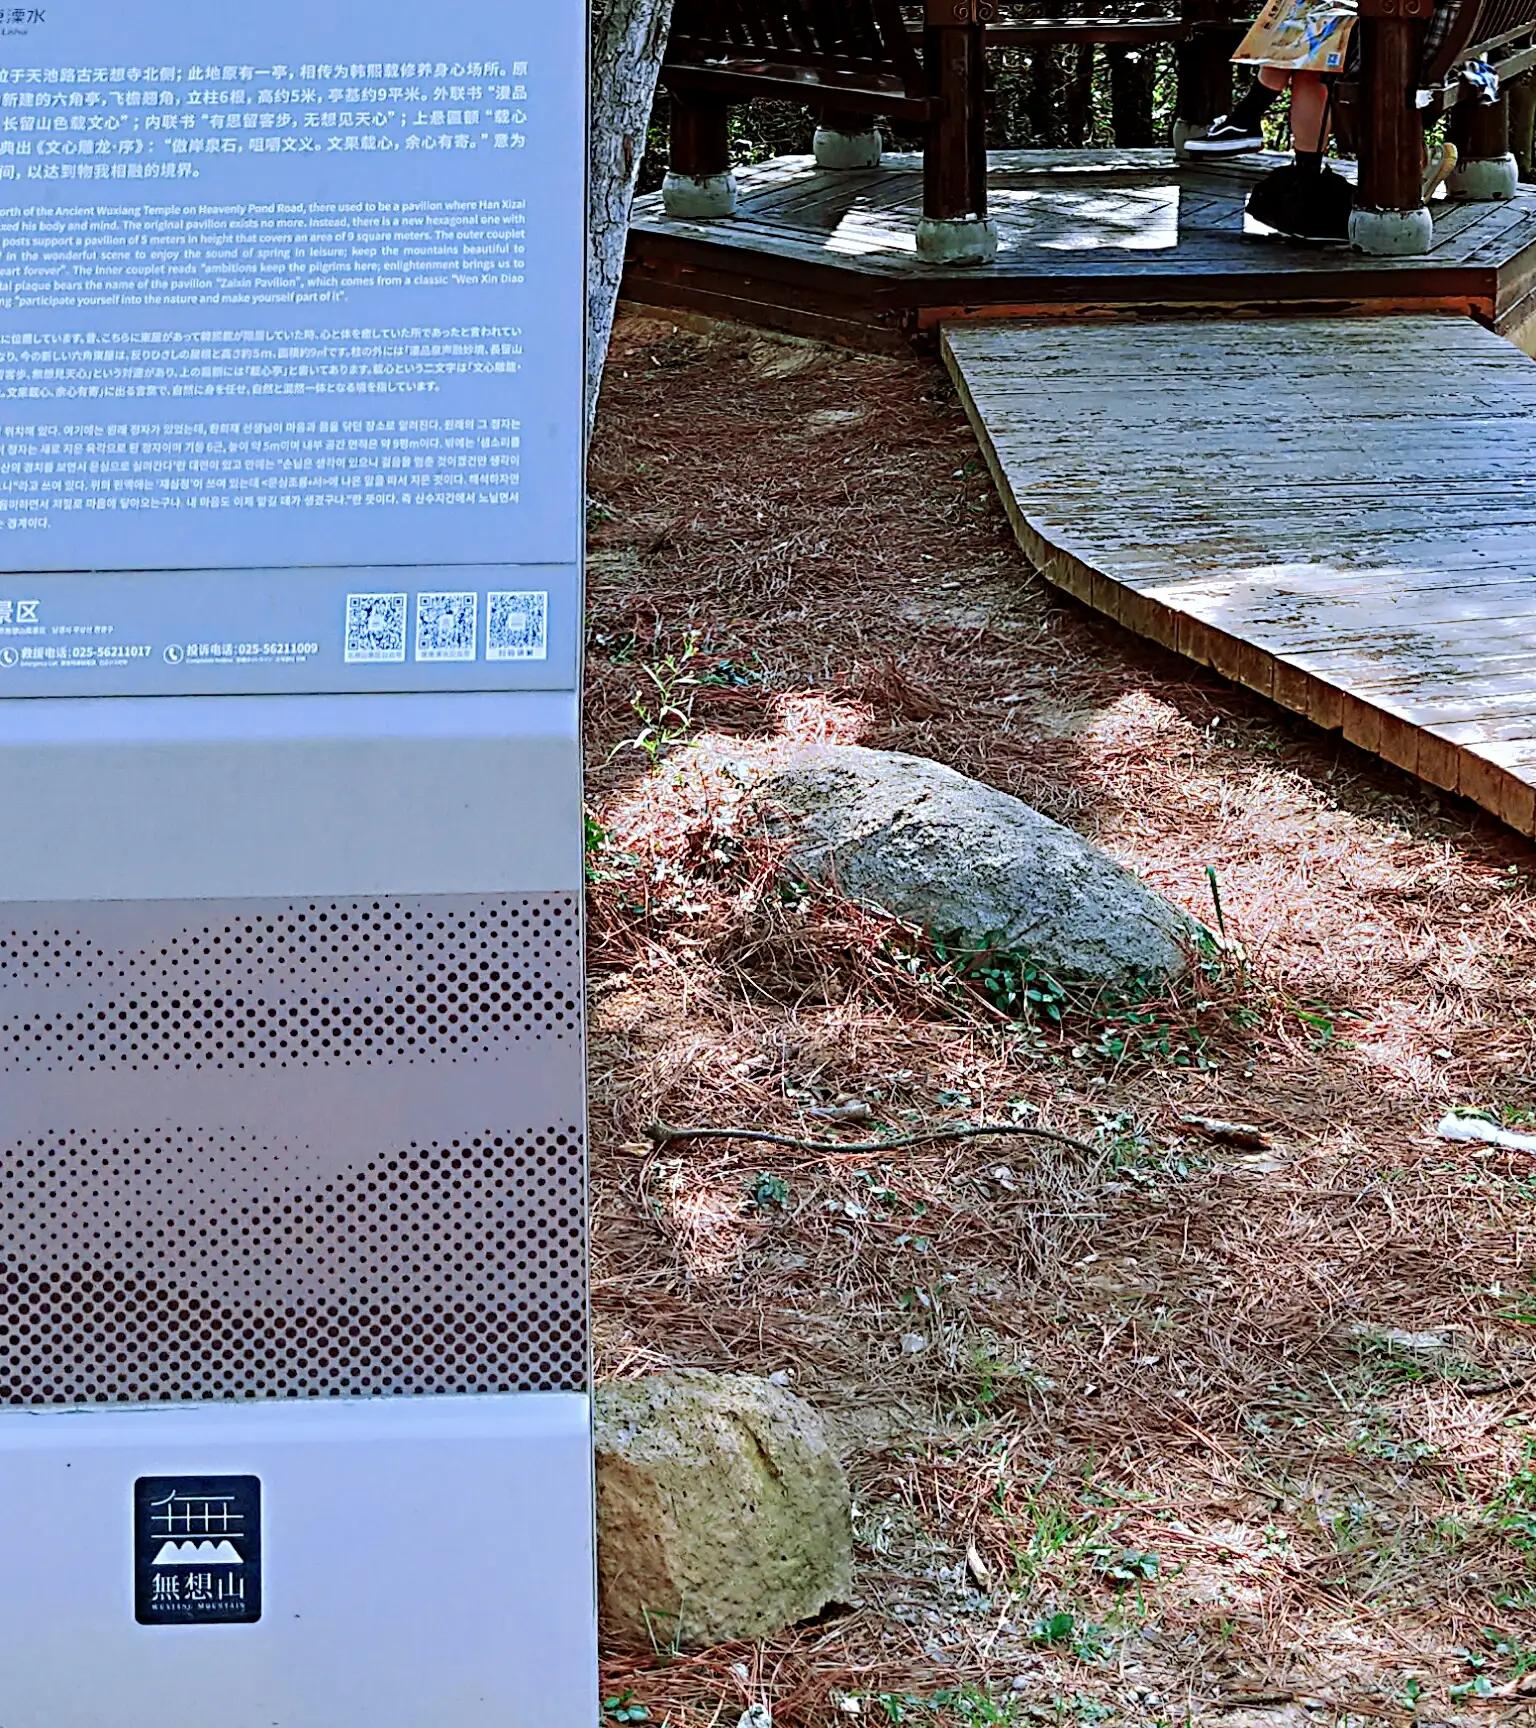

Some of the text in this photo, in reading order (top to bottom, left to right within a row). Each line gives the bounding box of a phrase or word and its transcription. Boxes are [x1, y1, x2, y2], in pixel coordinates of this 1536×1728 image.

[23, 206, 34, 216] of
[36, 205, 54, 216] the
[54, 205, 94, 216] Ancient
[96, 204, 141, 218] Wuxiang
[143, 204, 181, 216] Temple
[182, 206, 196, 214] on
[198, 203, 246, 216] Heavenly
[247, 203, 275, 213] Pond
[308, 201, 336, 212] there
[338, 201, 362, 212] used
[365, 202, 376, 211] to
[377, 199, 391, 211] be
[401, 200, 442, 213] pavilion
[444, 199, 477, 210] where
[479, 199, 499, 210] Han
[501, 198, 525, 209] Xizai
[21, 221, 36, 231] his
[39, 220, 66, 233] body
[67, 220, 88, 230] and
[122, 220, 142, 230] The
[143, 219, 183, 231] original
[185, 218, 227, 231] pavilion
[229, 218, 259, 228] exists
[260, 219, 274, 228] no
[352, 215, 379, 227] there
[381, 215, 390, 226] is
[401, 217, 423, 225] new
[426, 213, 478, 227] hexagonal
[480, 215, 500, 224] one
[502, 213, 525, 224] with
[2, 237, 30, 248] posts
[31, 236, 73, 247] support
[84, 234, 126, 247] pavilion
[127, 234, 139, 245] of
[149, 235, 185, 245] meters
[187, 234, 197, 244] in
[200, 233, 233, 246] height
[235, 233, 256, 243] that
[258, 234, 292, 243] covers
[294, 233, 307, 242] an
[309, 233, 332, 242] area
[334, 231, 346, 241] of
[356, 232, 391, 243] square
[434, 229, 454, 240] The
[456, 229, 484, 239] outer
[486, 228, 525, 240] couplet
[6, 251, 16, 261] in
[21, 250, 38, 261] the
[42, 249, 96, 261] wonderful
[101, 251, 130, 260] scene
[135, 250, 146, 260] to
[150, 249, 179, 262] enjoy
[183, 248, 201, 259] the
[205, 247, 238, 258] sound
[242, 247, 254, 258] of
[257, 247, 290, 260] spring
[295, 247, 305, 257] in
[351, 245, 377, 258] keep
[381, 245, 398, 256] the
[403, 244, 458, 255] mountains
[462, 243, 509, 254] beautiful
[513, 244, 525, 253] to
[72, 264, 92, 275] The
[95, 264, 123, 275] inner
[125, 263, 165, 276] couplet
[167, 262, 196, 274] reads
[260, 261, 285, 274] keep
[288, 261, 306, 272] the
[308, 261, 351, 273] pilgrims
[383, 259, 459, 272] enlightenment
[462, 258, 495, 271] brings
[497, 260, 510, 268] us
[513, 259, 524, 268] to
[14, 279, 51, 293] plaque
[53, 279, 82, 290] bears
[85, 279, 102, 290] the
[105, 281, 135, 289] name
[137, 278, 149, 289] of
[151, 279, 168, 289] the
[170, 277, 212, 290] pavilion
[307, 276, 338, 287] which
[340, 277, 374, 286] comes
[376, 275, 402, 286] from
[413, 274, 448, 285] classic
[480, 273, 497, 284] Xin
[500, 273, 524, 283] Diao
[77, 294, 119, 307] yourself
[121, 294, 142, 304] into
[144, 293, 161, 304] the
[163, 294, 197, 304] nature
[199, 292, 219, 304] and
[221, 293, 250, 303] make
[251, 291, 294, 304] yourself
[295, 292, 317, 304] part
[319, 290, 330, 302] of
[152, 1571, 244, 1601] 無想山
